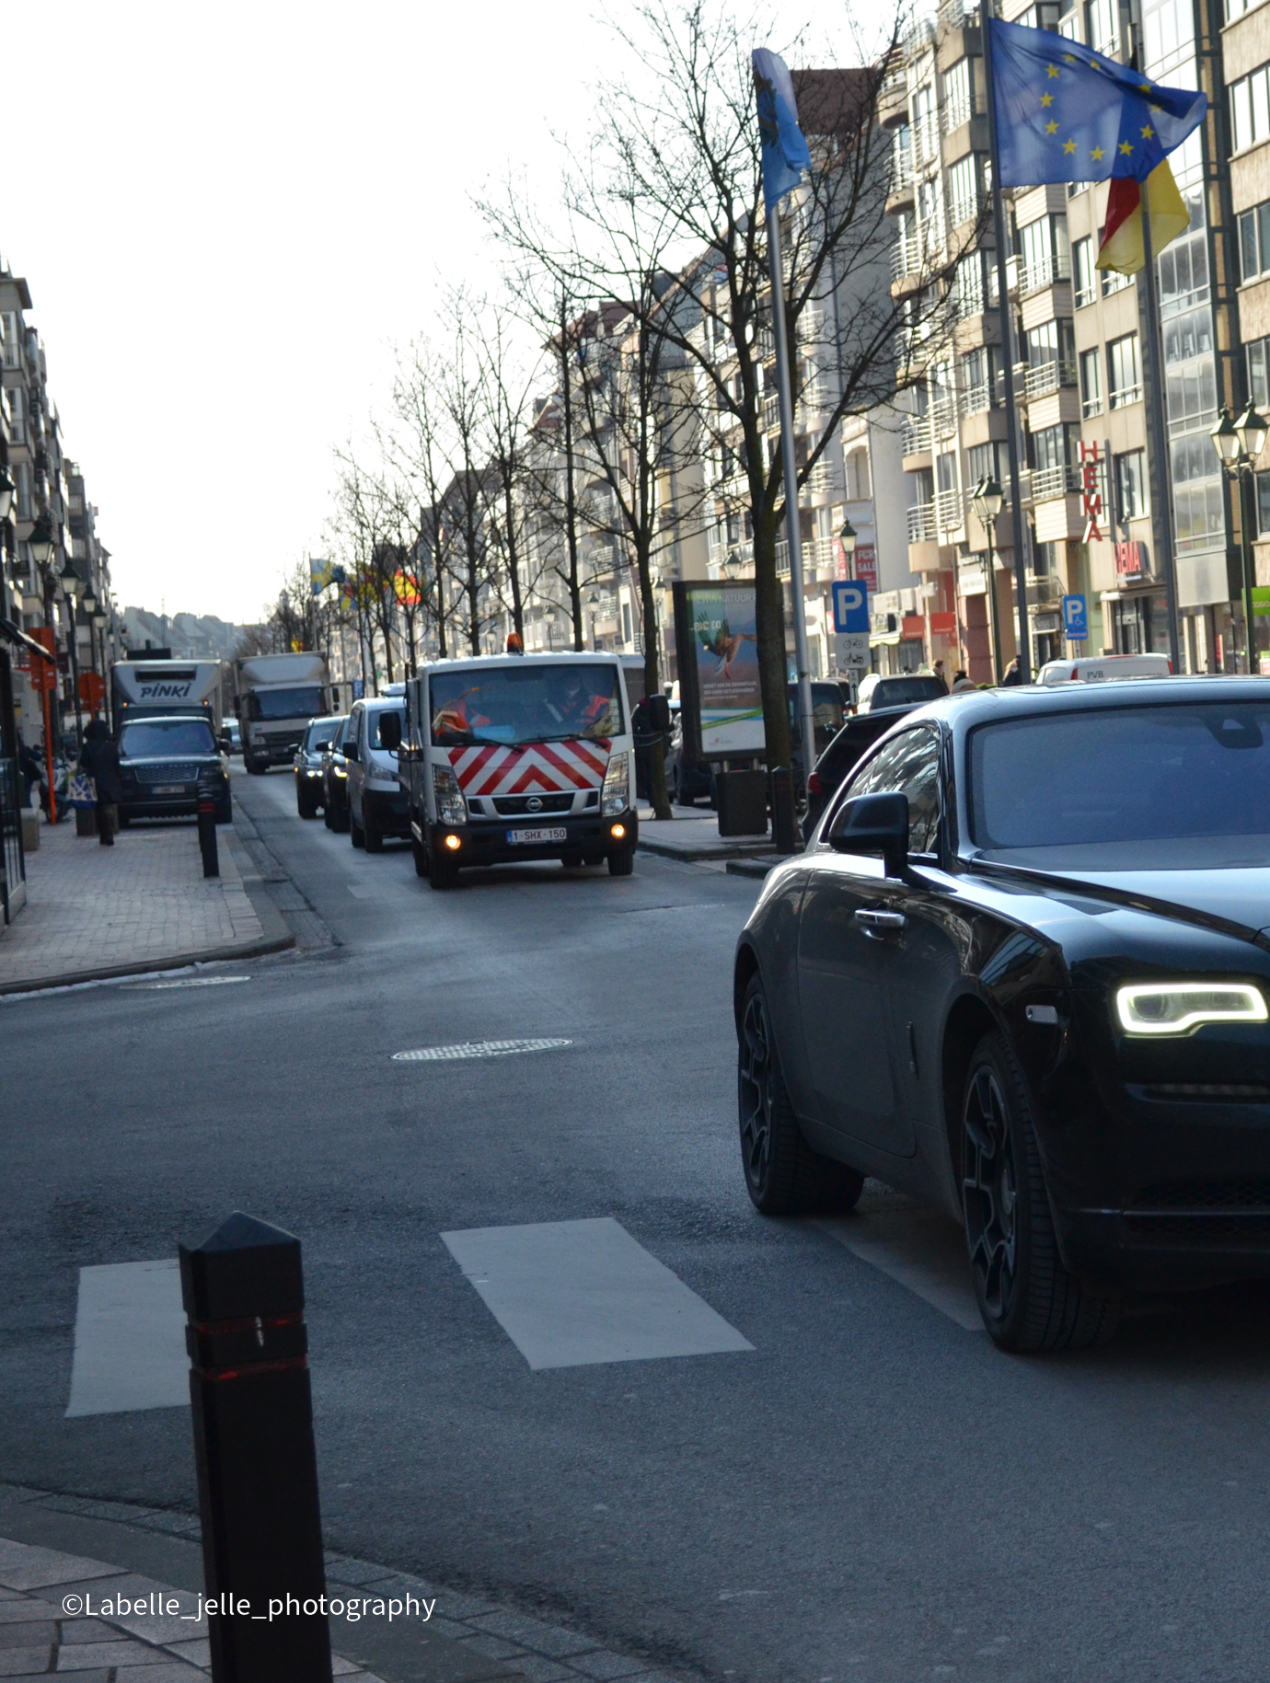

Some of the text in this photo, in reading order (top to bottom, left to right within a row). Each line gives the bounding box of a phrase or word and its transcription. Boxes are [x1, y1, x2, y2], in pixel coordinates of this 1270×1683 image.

[1077, 440, 1103, 544] HEMA
[857, 562, 876, 573] SALE
[1116, 540, 1142, 574] HEMA
[837, 588, 863, 626] P
[1066, 600, 1083, 624] P
[1087, 670, 1104, 679] PVB
